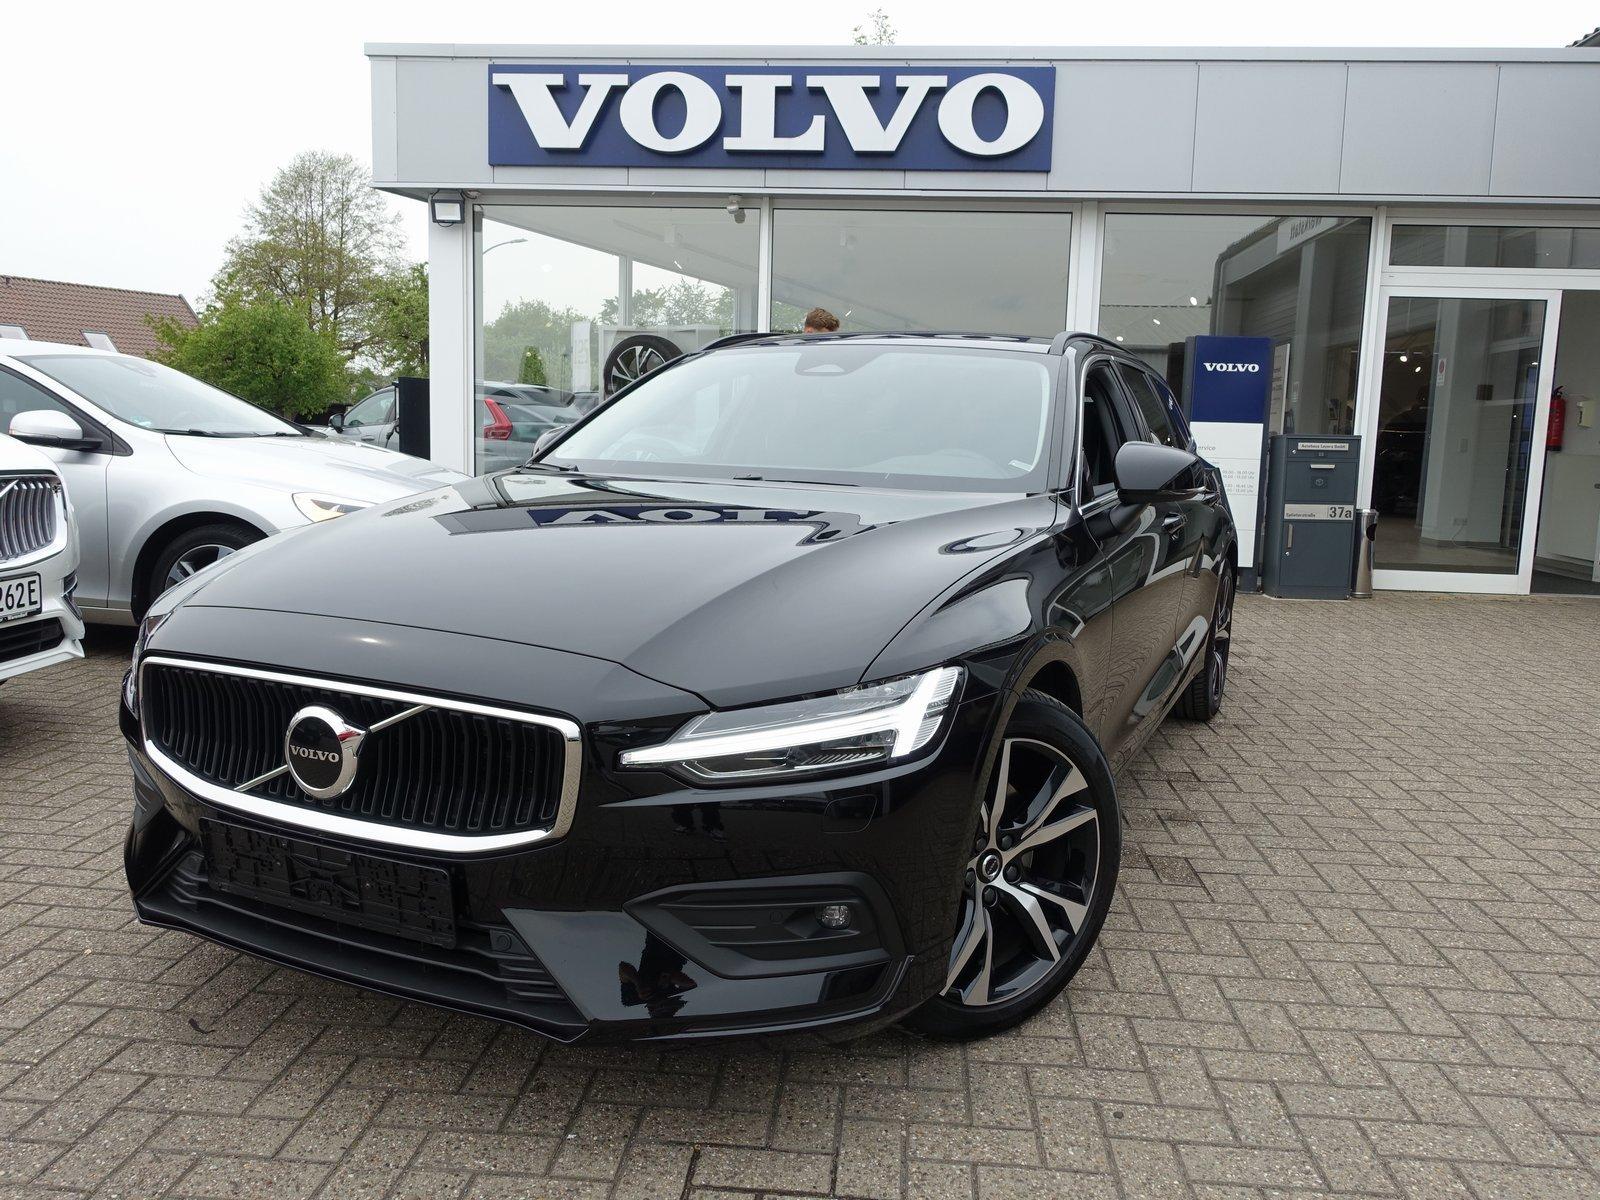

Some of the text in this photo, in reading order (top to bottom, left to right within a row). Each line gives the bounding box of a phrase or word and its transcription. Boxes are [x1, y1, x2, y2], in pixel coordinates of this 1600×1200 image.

[492, 71, 1045, 157] VOLVO
[1203, 362, 1260, 373] VOLVO
[1329, 506, 1352, 518] 37a
[290, 744, 340, 763] VOLVO
